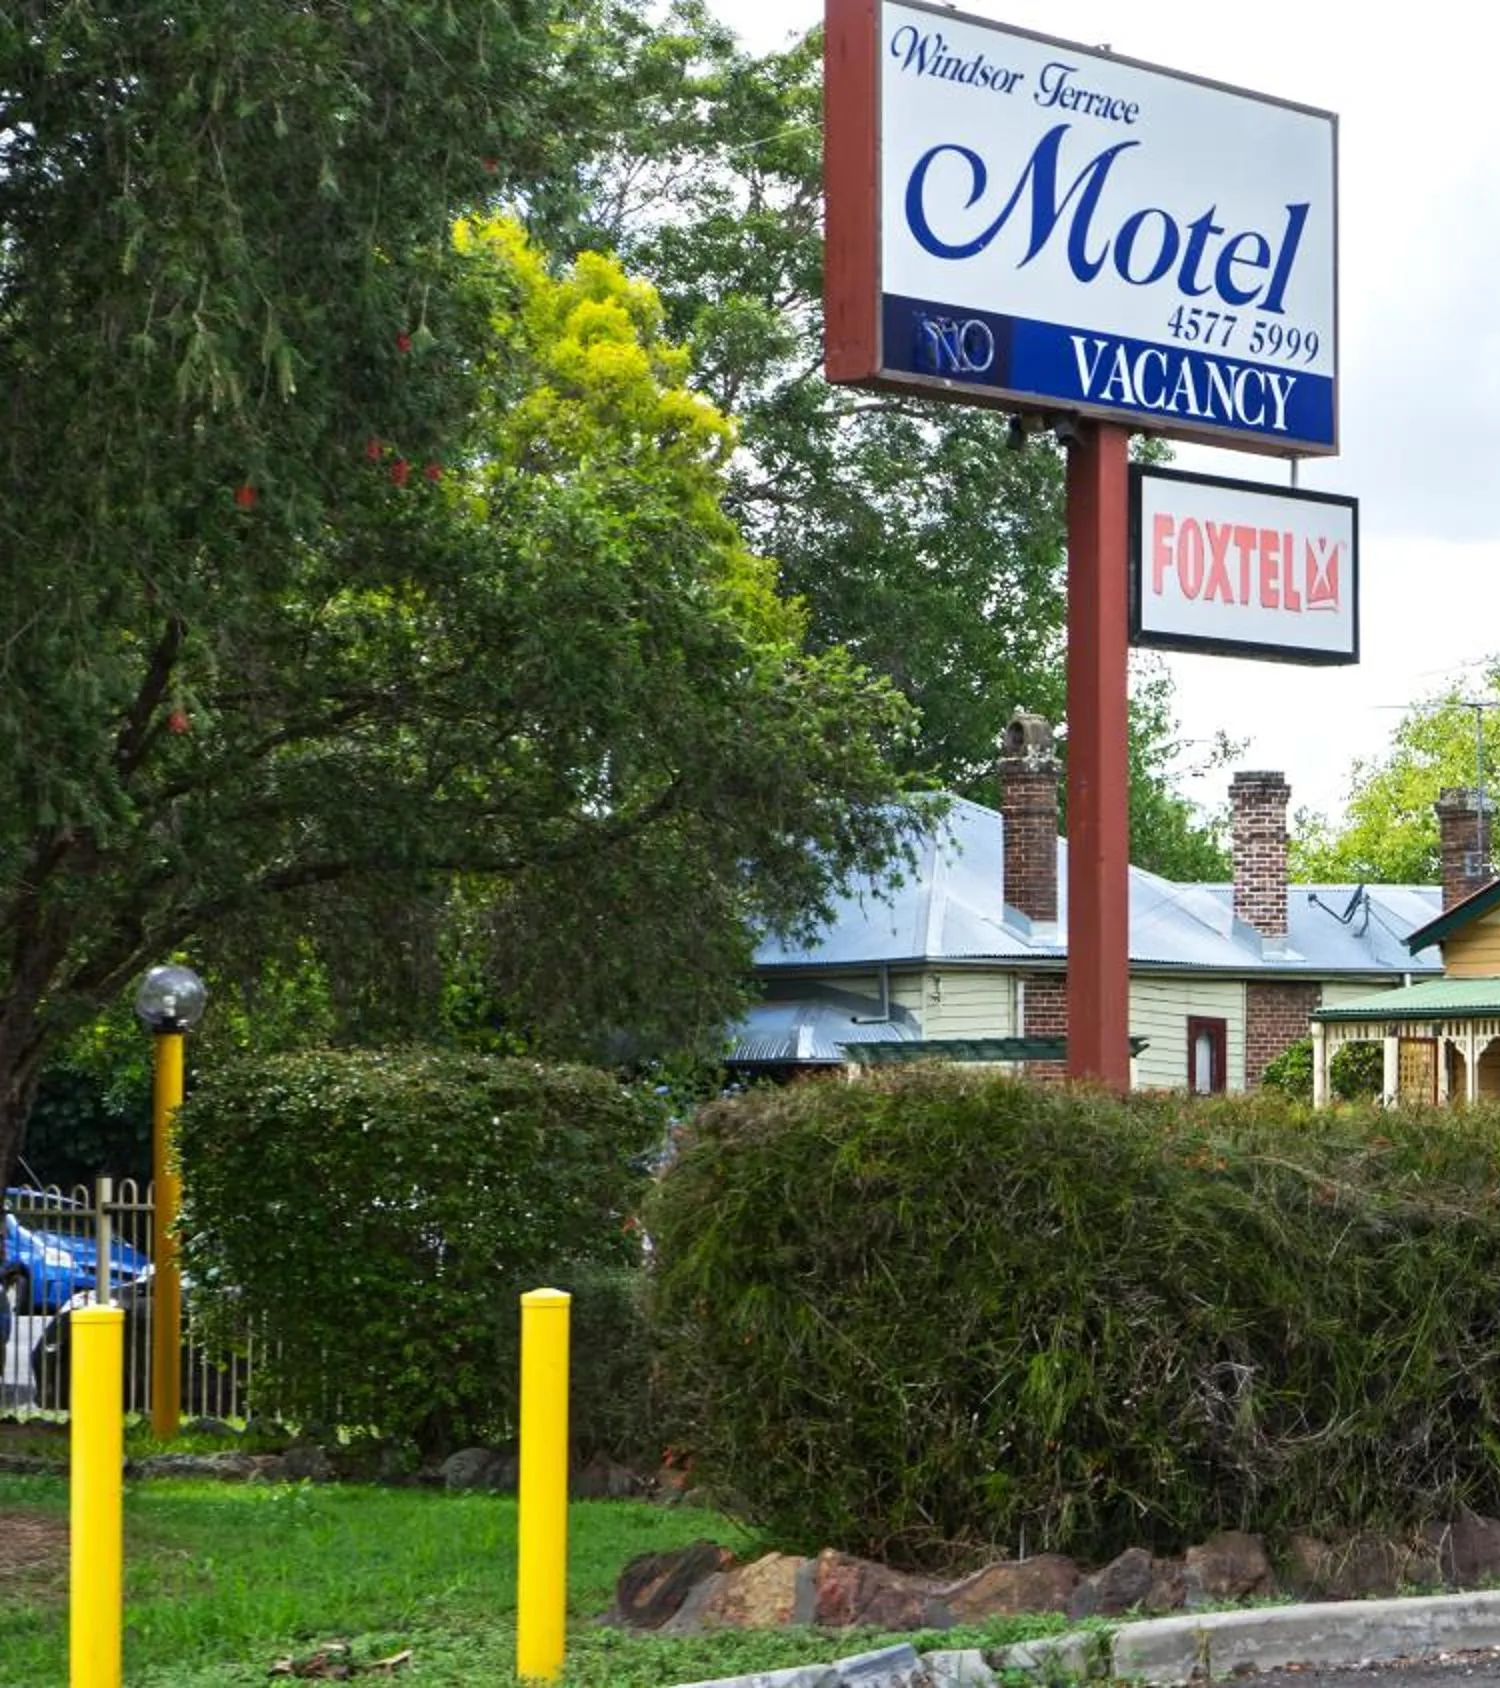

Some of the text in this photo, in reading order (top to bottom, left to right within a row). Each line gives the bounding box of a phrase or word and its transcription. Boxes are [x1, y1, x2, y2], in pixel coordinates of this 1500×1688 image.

[891, 25, 1140, 124] Windsor Terrace
[905, 123, 1311, 315] Motel
[922, 318, 1297, 431] NO VACANCY
[1167, 304, 1319, 366] 4577 5999
[1152, 512, 1302, 613] FOXTEL
